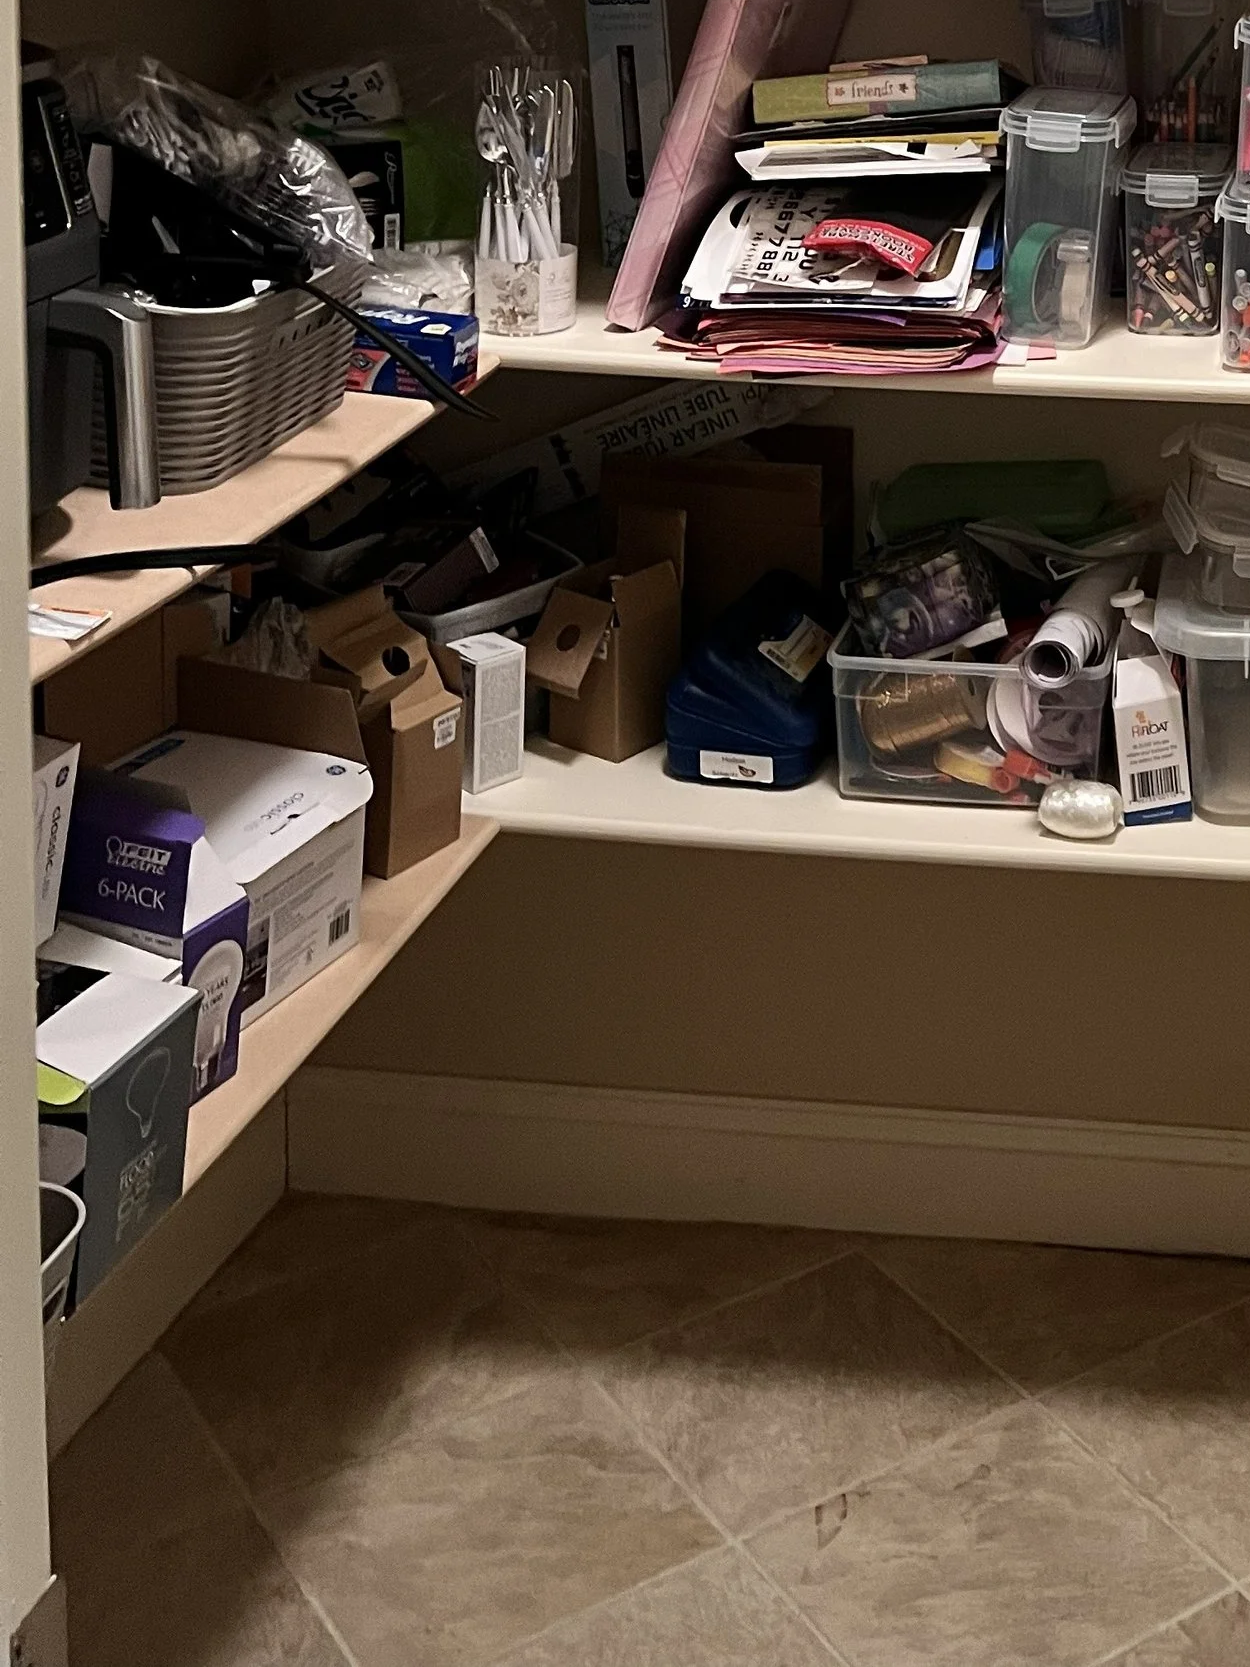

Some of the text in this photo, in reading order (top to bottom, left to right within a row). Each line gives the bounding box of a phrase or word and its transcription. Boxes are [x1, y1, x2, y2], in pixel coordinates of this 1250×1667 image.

[682, 384, 732, 417] TUBE
[672, 408, 742, 448] LINEAR
[97, 877, 167, 912] 6-PACK
